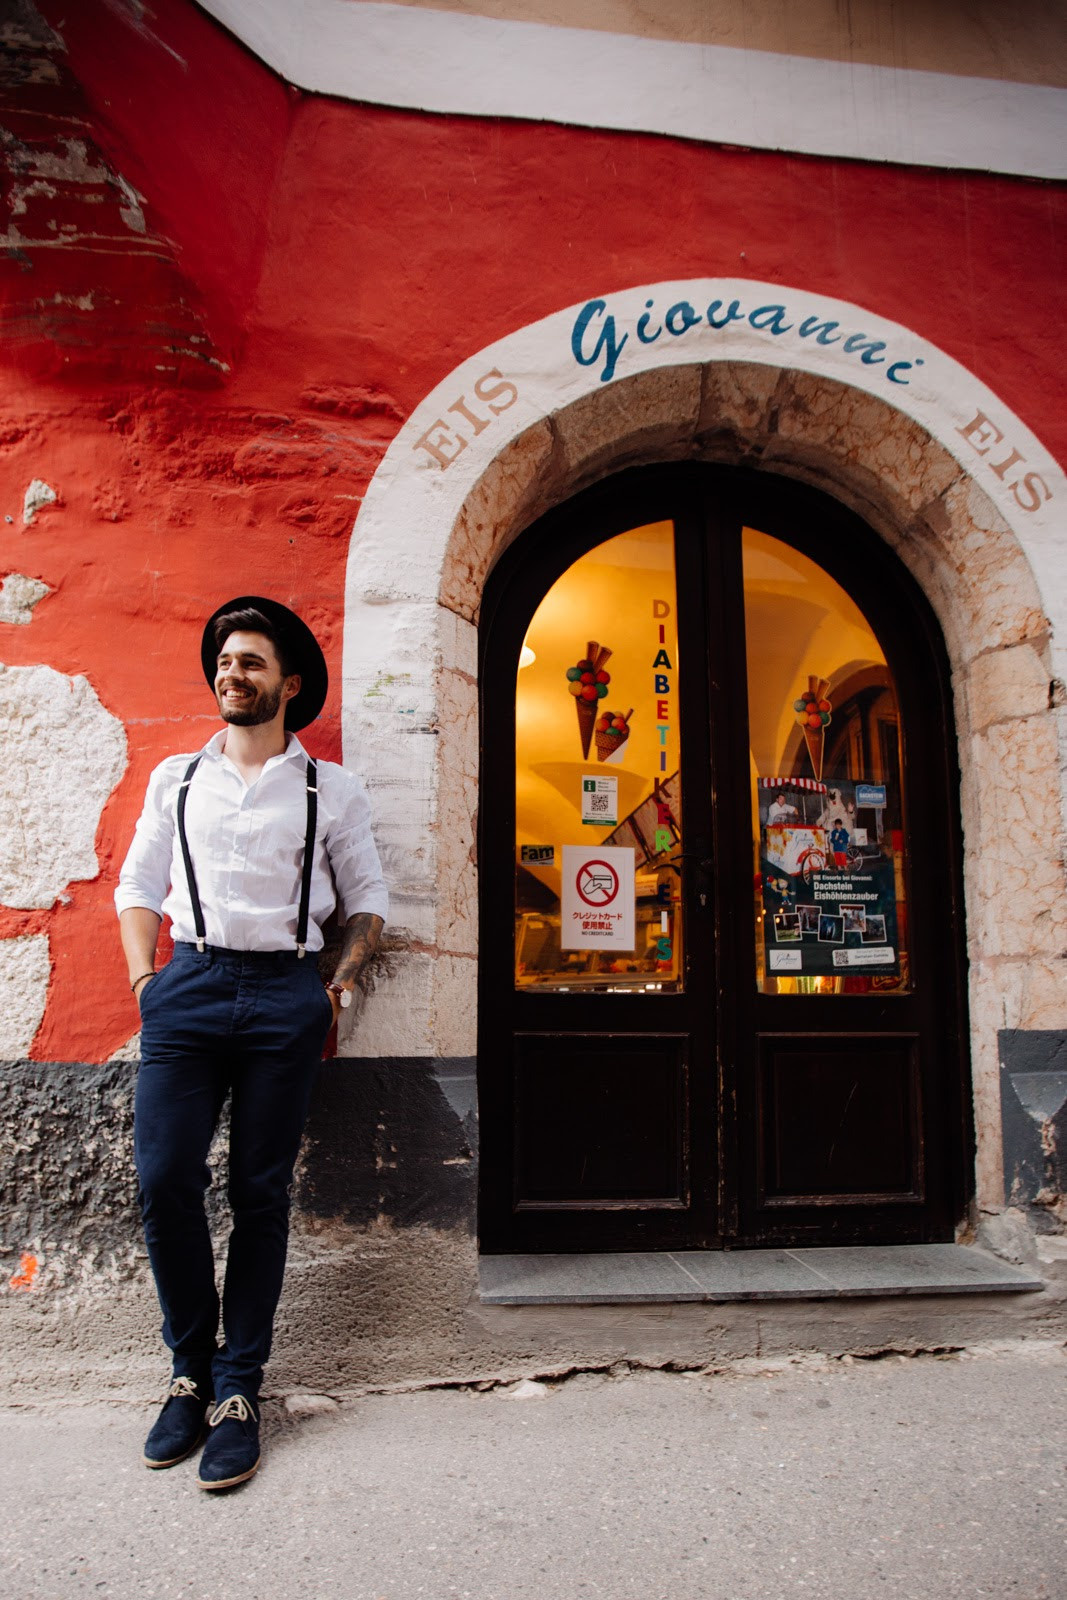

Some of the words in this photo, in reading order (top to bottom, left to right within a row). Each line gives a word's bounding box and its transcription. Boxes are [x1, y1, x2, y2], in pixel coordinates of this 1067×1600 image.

[571, 298, 925, 384] Giovanni
[413, 367, 519, 470] EIS
[954, 408, 1055, 513] EIS
[652, 599, 672, 852] DIABETIKER
[572, 912, 622, 920] クレジットカード
[656, 884, 673, 962] EIS
[813, 881, 853, 891] Dachstein
[814, 891, 879, 901] Eishöhlenzauber
[582, 921, 613, 930] 使用禁止
